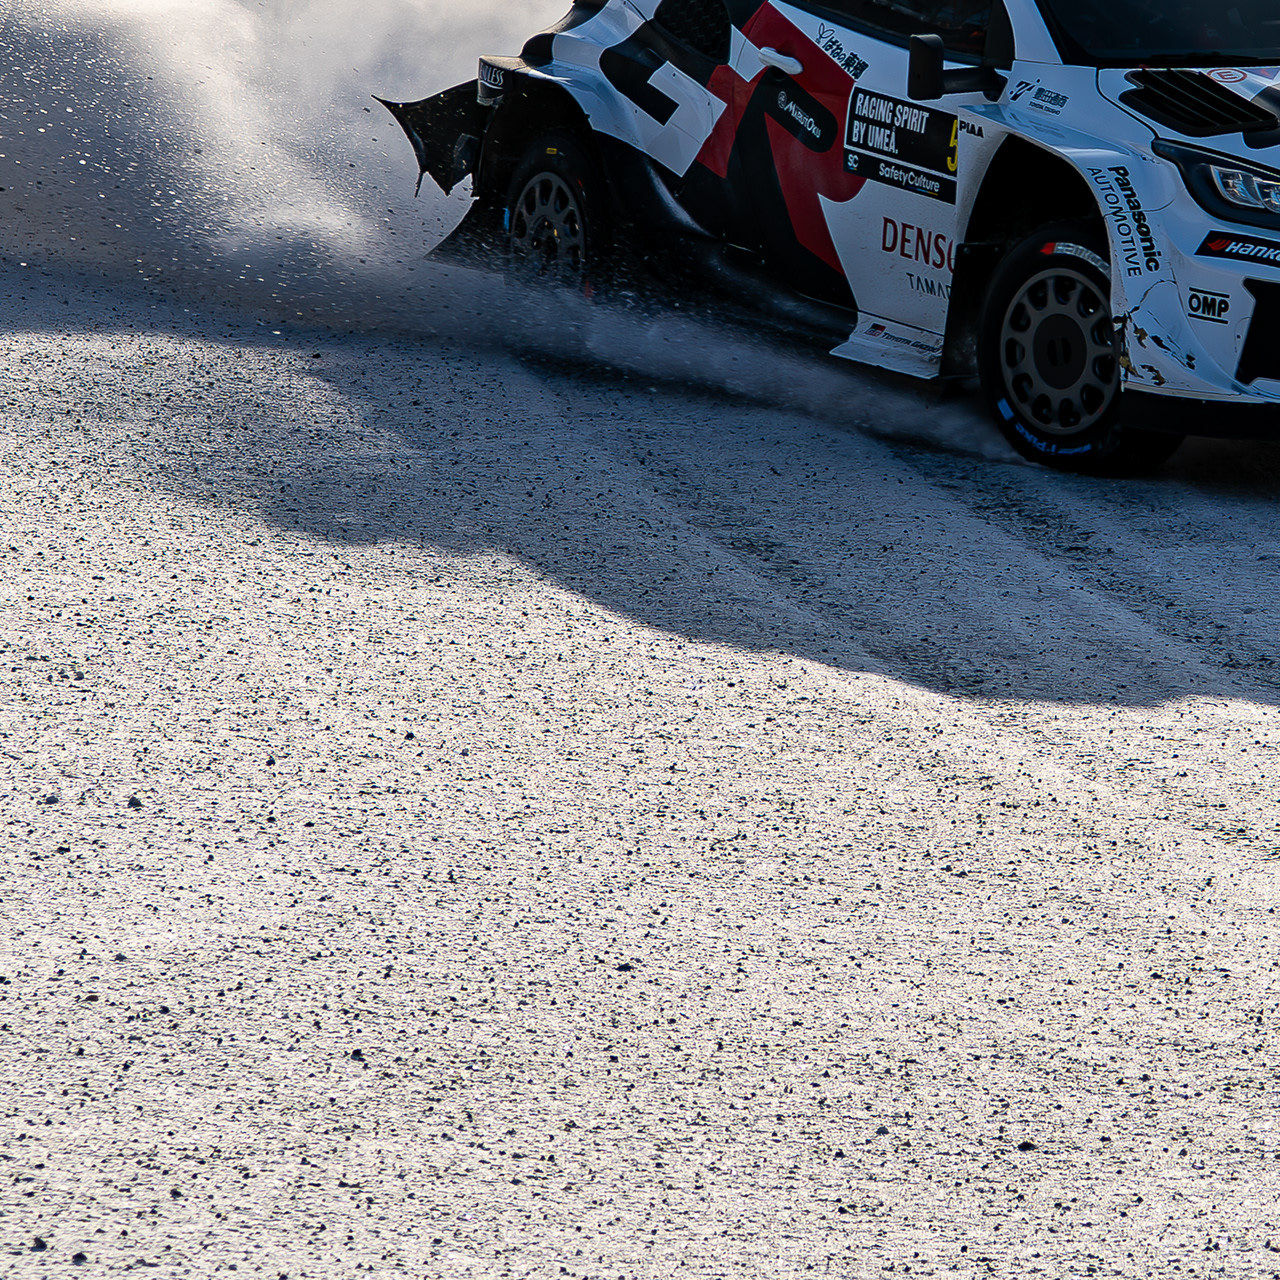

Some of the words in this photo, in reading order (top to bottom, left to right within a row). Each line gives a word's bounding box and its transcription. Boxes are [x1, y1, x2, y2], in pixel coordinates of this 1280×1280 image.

[855, 93, 893, 124] RACING
[894, 104, 929, 134] SPIRIT
[959, 120, 984, 138] PIAA
[852, 120, 867, 143] BY
[867, 125, 899, 155] UMEÅ.
[847, 153, 859, 168] SC
[879, 163, 940, 193] SafetyCulture
[1087, 167, 1142, 278] AUTOMOTIVE
[1107, 165, 1160, 273] Panasonic
[1188, 293, 1230, 317] OMP
